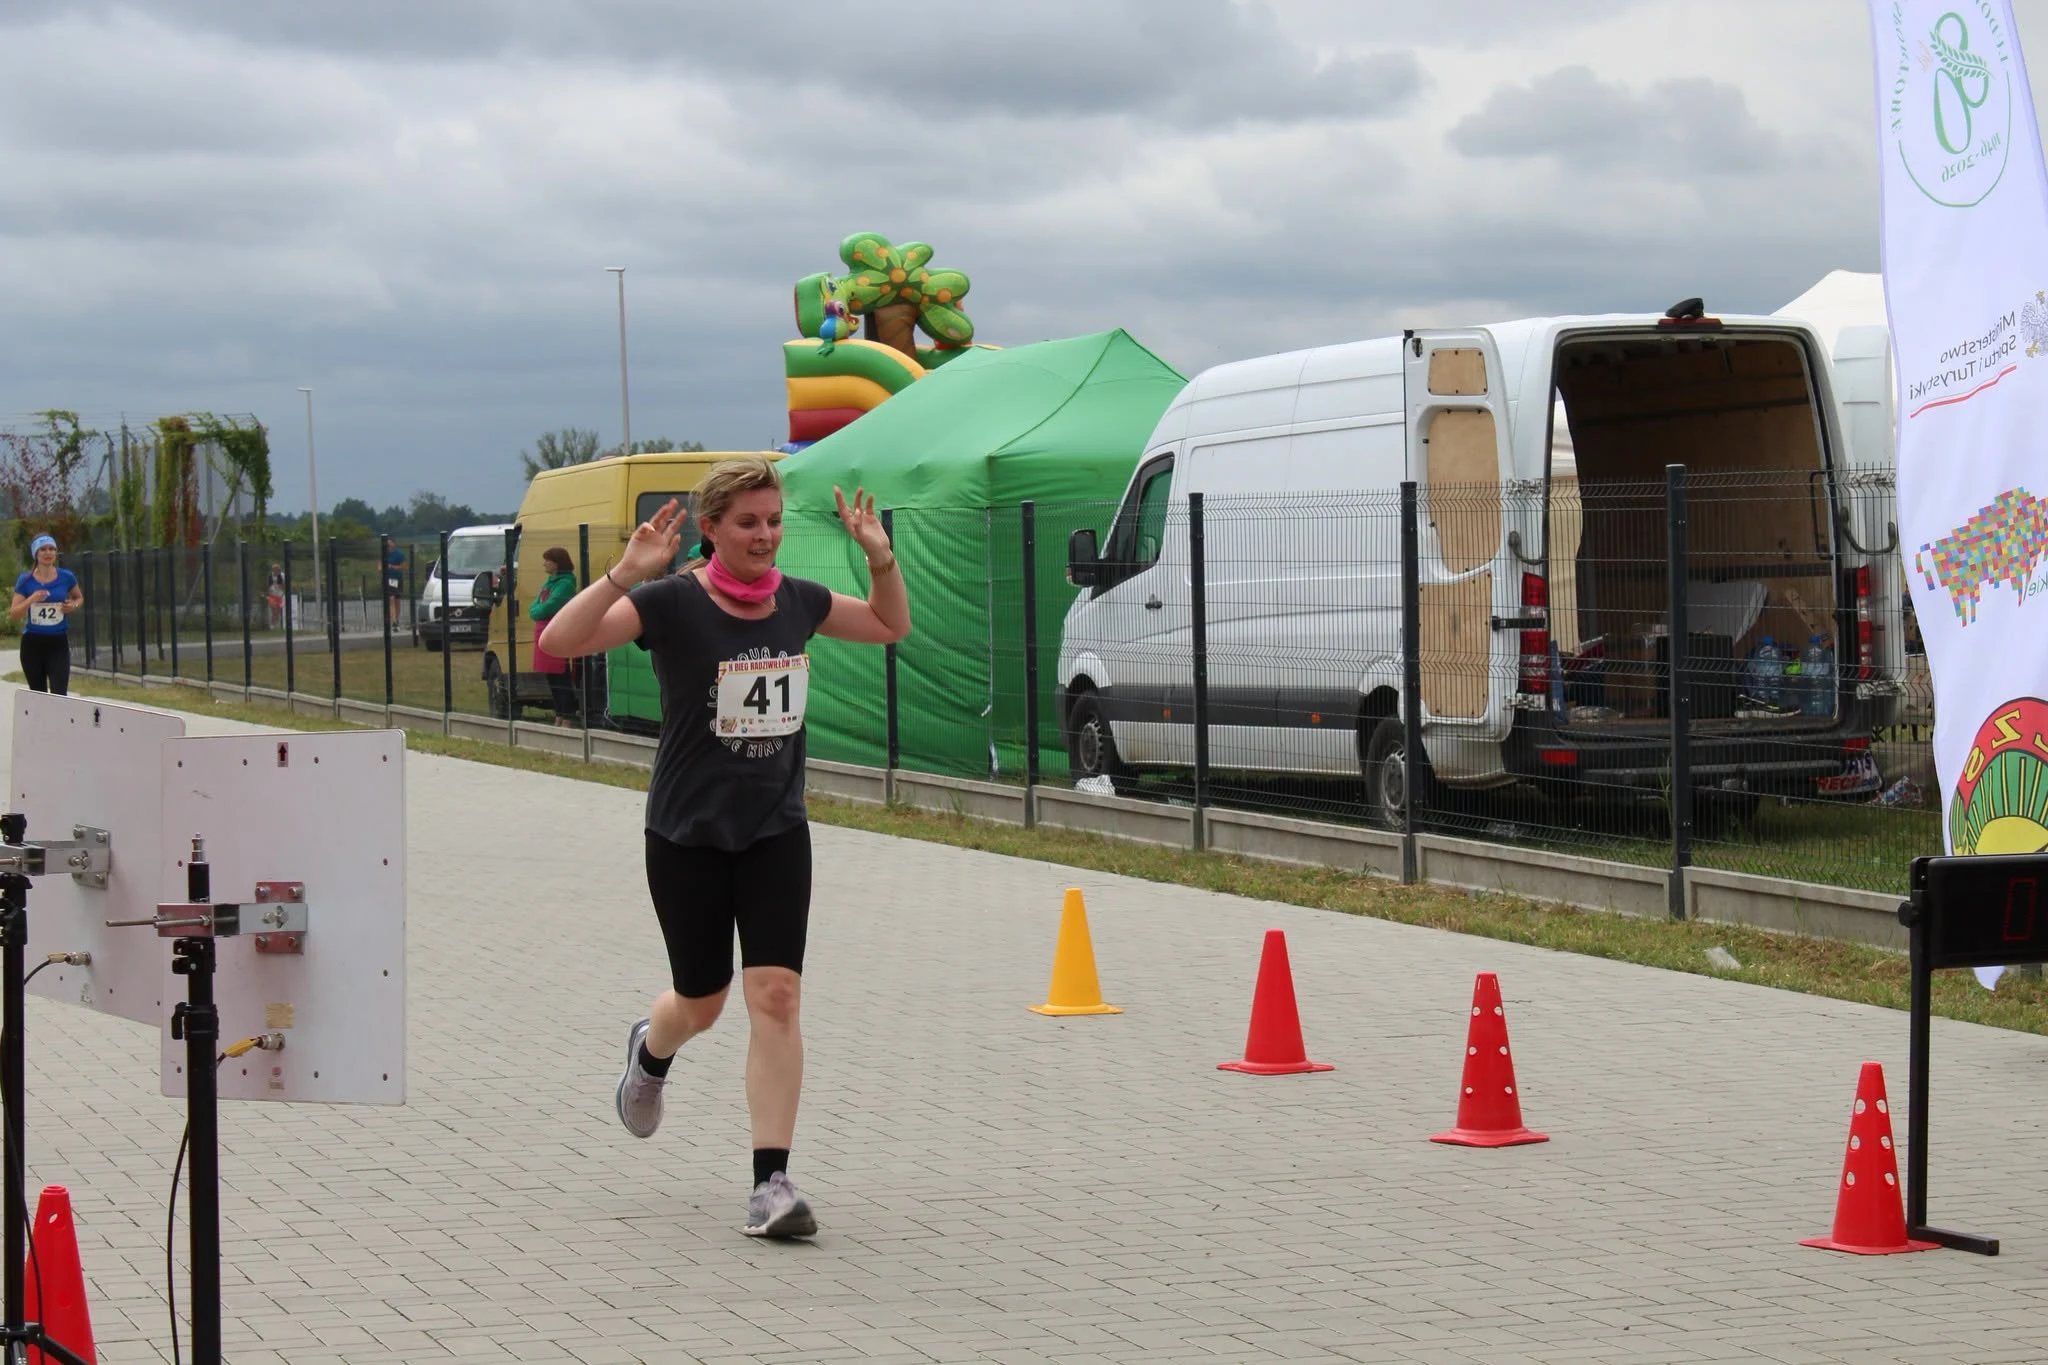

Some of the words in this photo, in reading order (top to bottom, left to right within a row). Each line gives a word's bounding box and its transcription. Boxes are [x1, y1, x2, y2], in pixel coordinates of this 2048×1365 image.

[38, 608, 57, 619] 42
[743, 673, 790, 715] 41
[746, 737, 784, 758] KIND
[2002, 876, 2038, 942] 0
